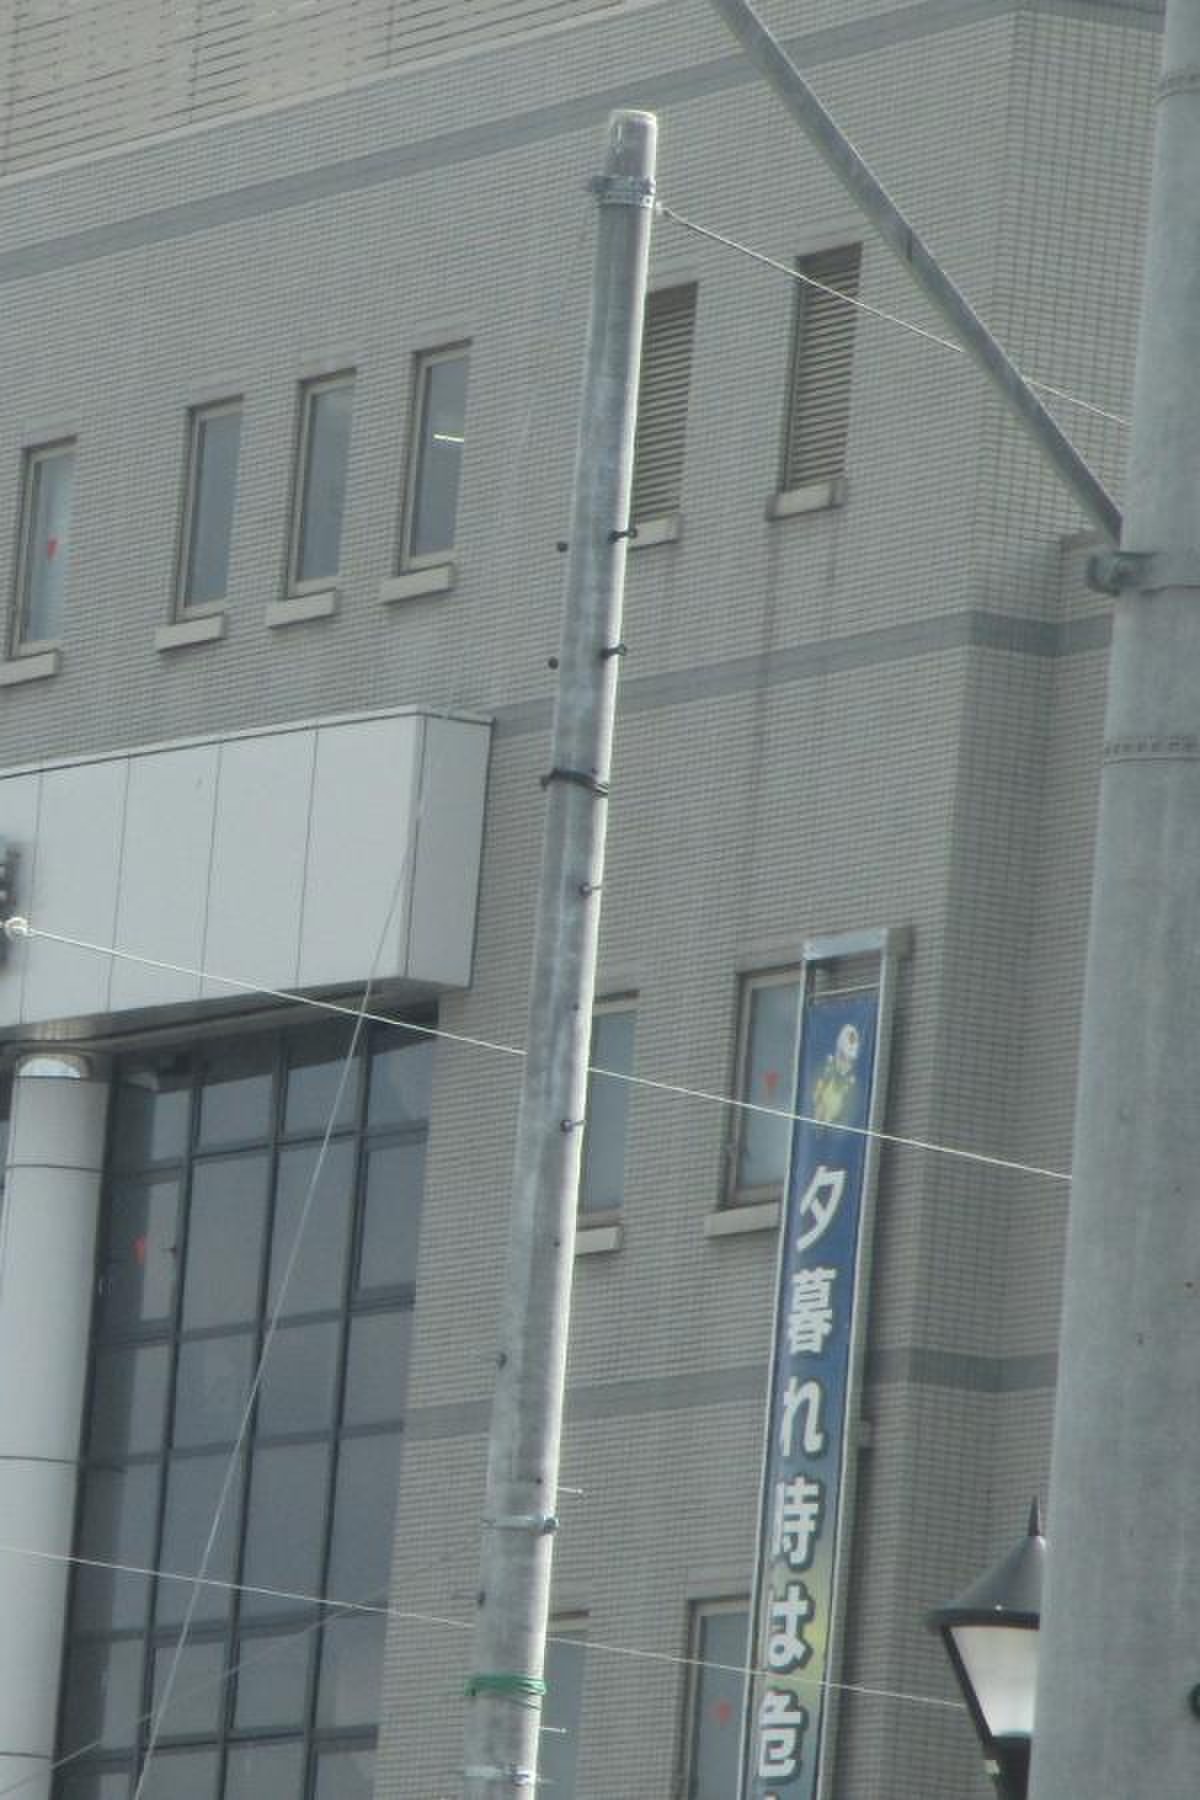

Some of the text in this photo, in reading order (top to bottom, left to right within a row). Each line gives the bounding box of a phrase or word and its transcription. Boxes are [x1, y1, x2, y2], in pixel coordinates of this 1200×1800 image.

[757, 1164, 847, 1800] 夕暮れ時は危
